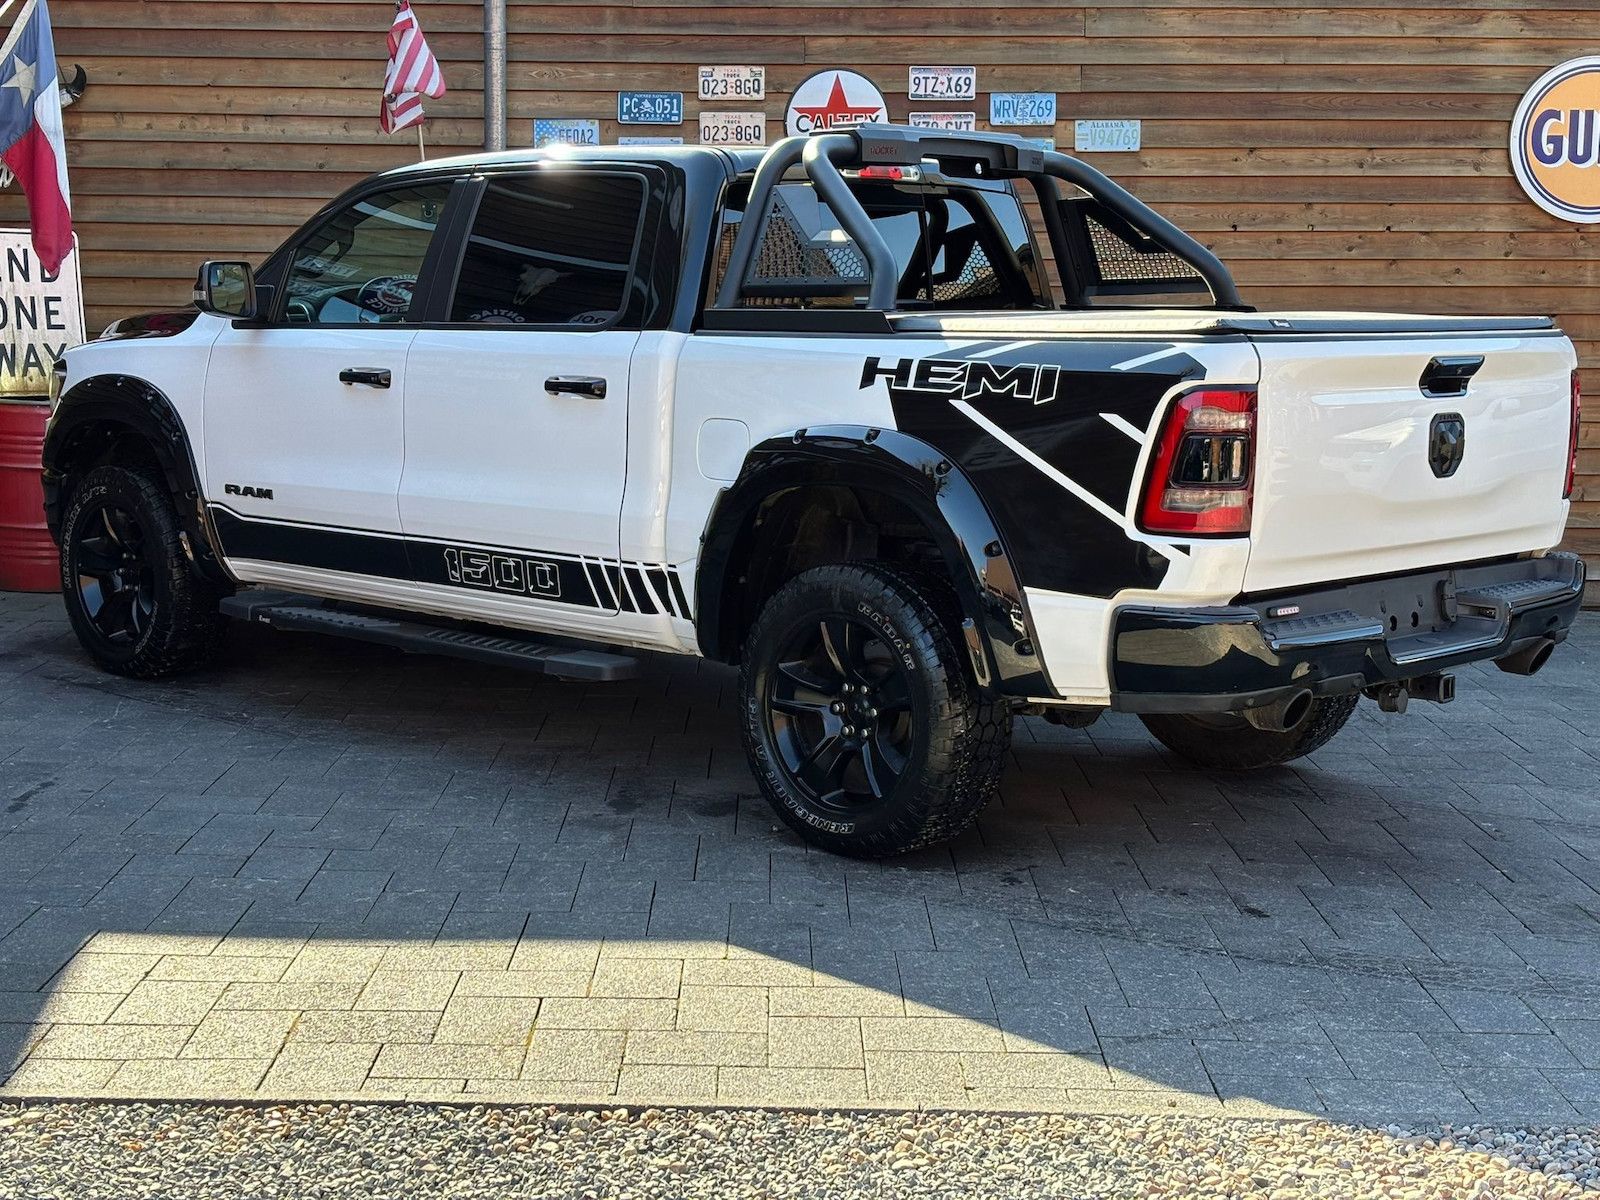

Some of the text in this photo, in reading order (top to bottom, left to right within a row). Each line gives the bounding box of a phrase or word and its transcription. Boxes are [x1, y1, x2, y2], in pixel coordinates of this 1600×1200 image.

[702, 78, 761, 95] 023 8GQ
[913, 76, 972, 94] 9TZ X69
[623, 97, 679, 113] PC 051
[993, 100, 1053, 118] WRV 269
[703, 125, 761, 141] 023 8GQ
[1090, 129, 1139, 146] V94769
[1532, 109, 1600, 165] GU
[859, 356, 1061, 405] HEMI
[224, 484, 274, 500] RAM
[443, 548, 561, 598] 1500
[766, 770, 856, 835] RENEGADE
